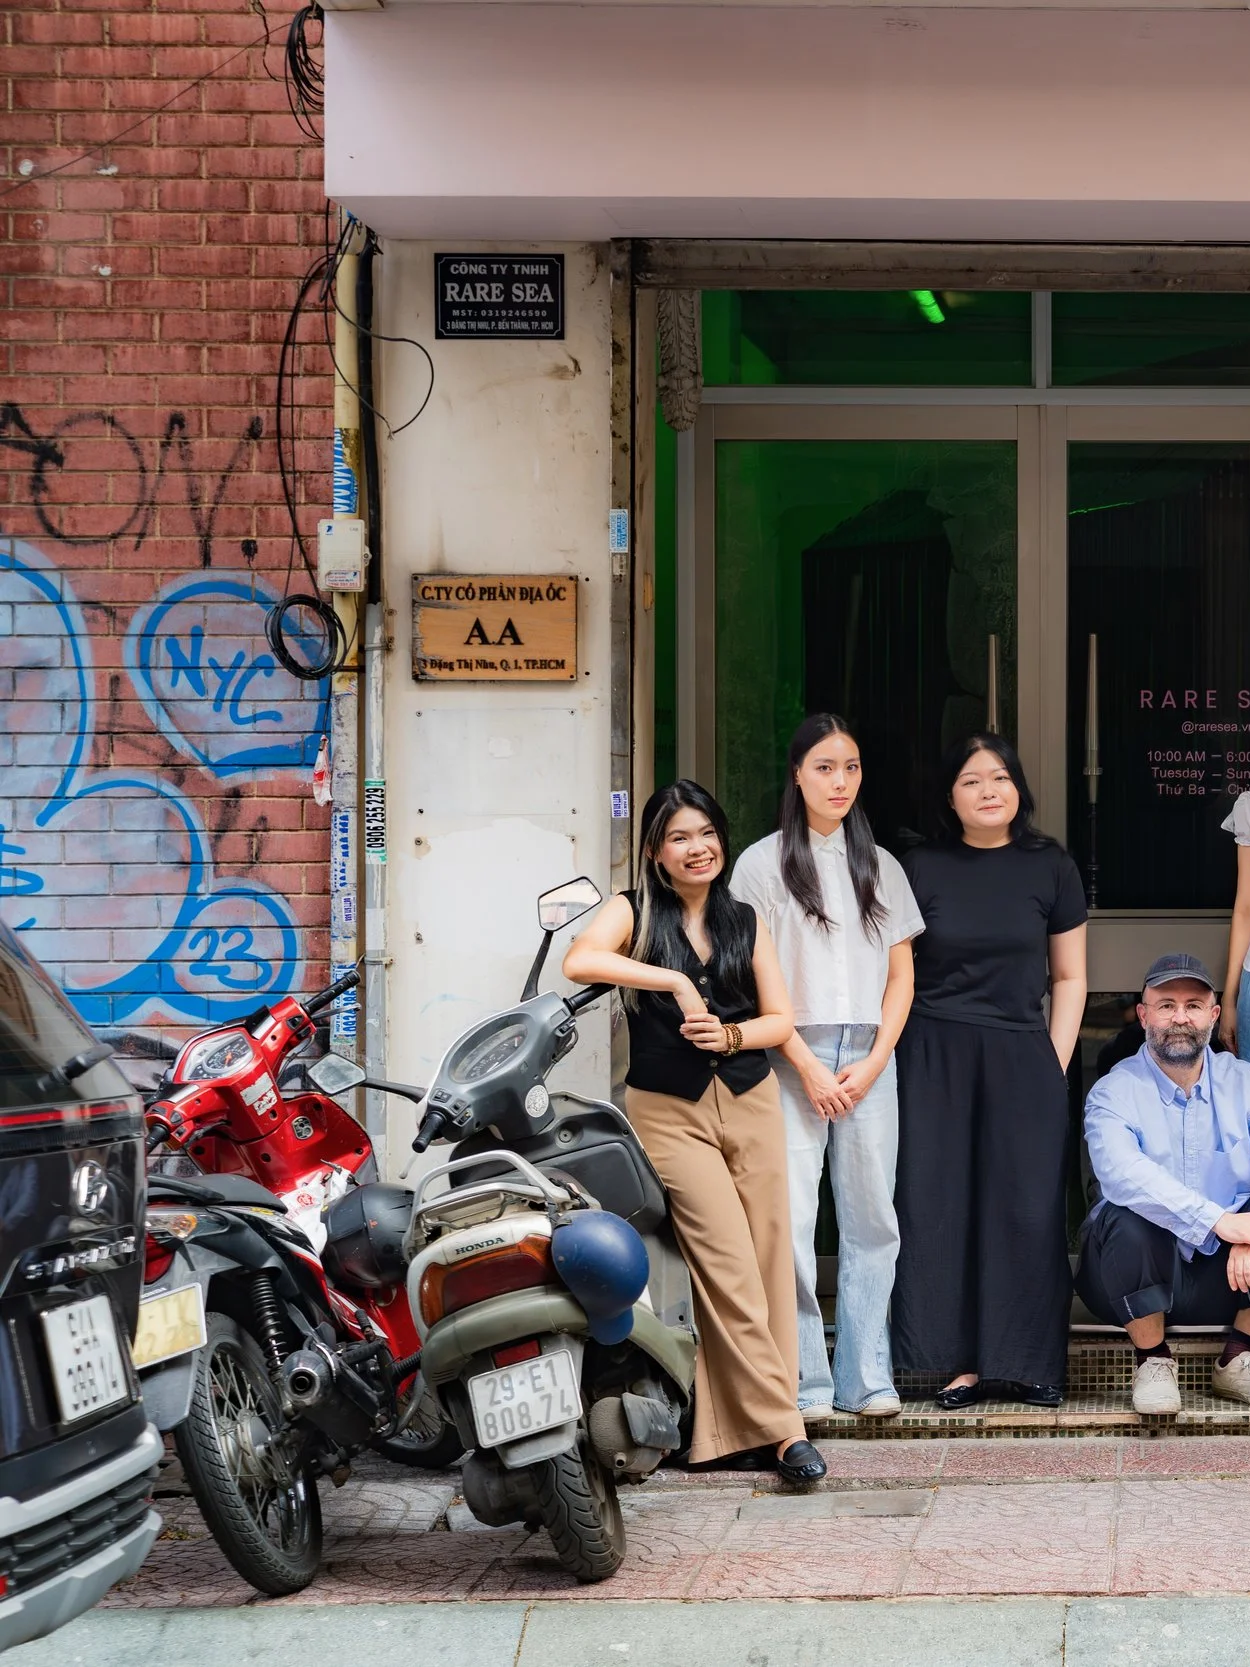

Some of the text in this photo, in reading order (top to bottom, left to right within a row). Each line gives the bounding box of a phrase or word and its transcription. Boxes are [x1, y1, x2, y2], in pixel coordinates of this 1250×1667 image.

[450, 261, 549, 275] CÔNG TY TNHH
[444, 282, 554, 302] RARE SEA
[452, 309, 478, 317] MST:
[421, 585, 453, 601] C.TY
[463, 616, 524, 646] A.A
[164, 624, 282, 726] NYC
[1140, 689, 1218, 709] RARE
[1147, 750, 1182, 763] 10:00
[1184, 750, 1207, 763] AM
[1151, 766, 1206, 781] Tuesday
[1188, 784, 1206, 796] Ba
[365, 787, 385, 848] 0906 255 229
[188, 927, 273, 990] 23
[454, 1236, 505, 1255] HONDA
[484, 1359, 559, 1408] 29-E1
[483, 1389, 574, 1440] 808.74
